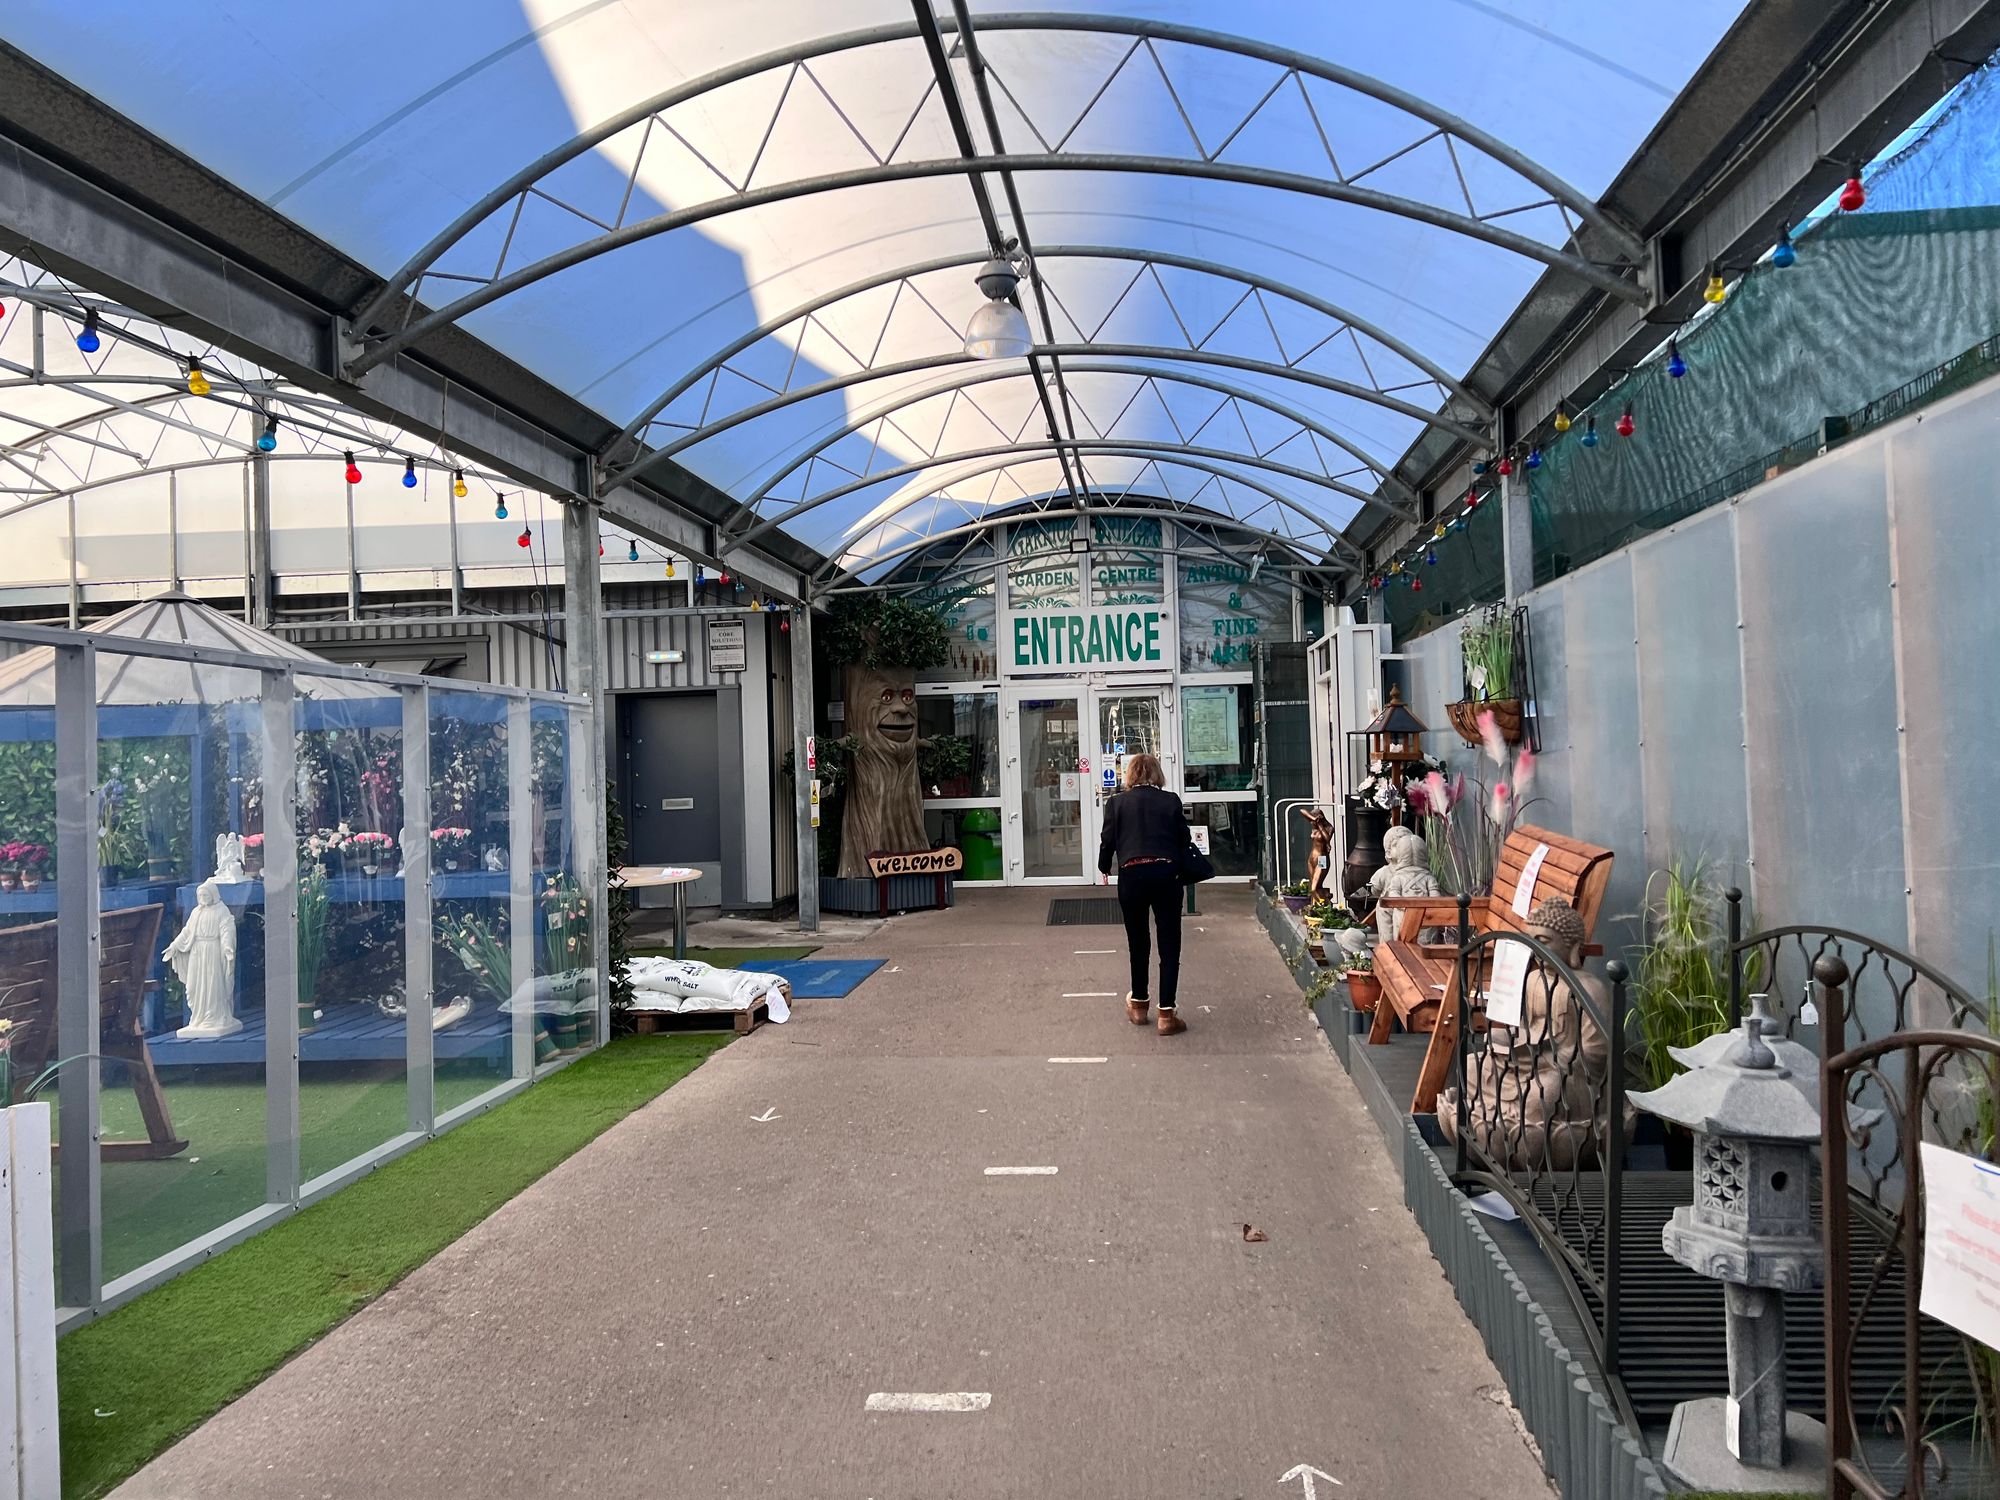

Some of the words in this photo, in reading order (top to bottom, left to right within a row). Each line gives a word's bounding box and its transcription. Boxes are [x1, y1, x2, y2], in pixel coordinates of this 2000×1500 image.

[1015, 571, 1073, 588] GARDEN
[1098, 568, 1157, 584] CENTRE
[1228, 592, 1242, 609] &
[1212, 618, 1258, 636] FINE
[1014, 612, 1161, 666] ENTRANCE
[682, 981, 700, 990] SALT
